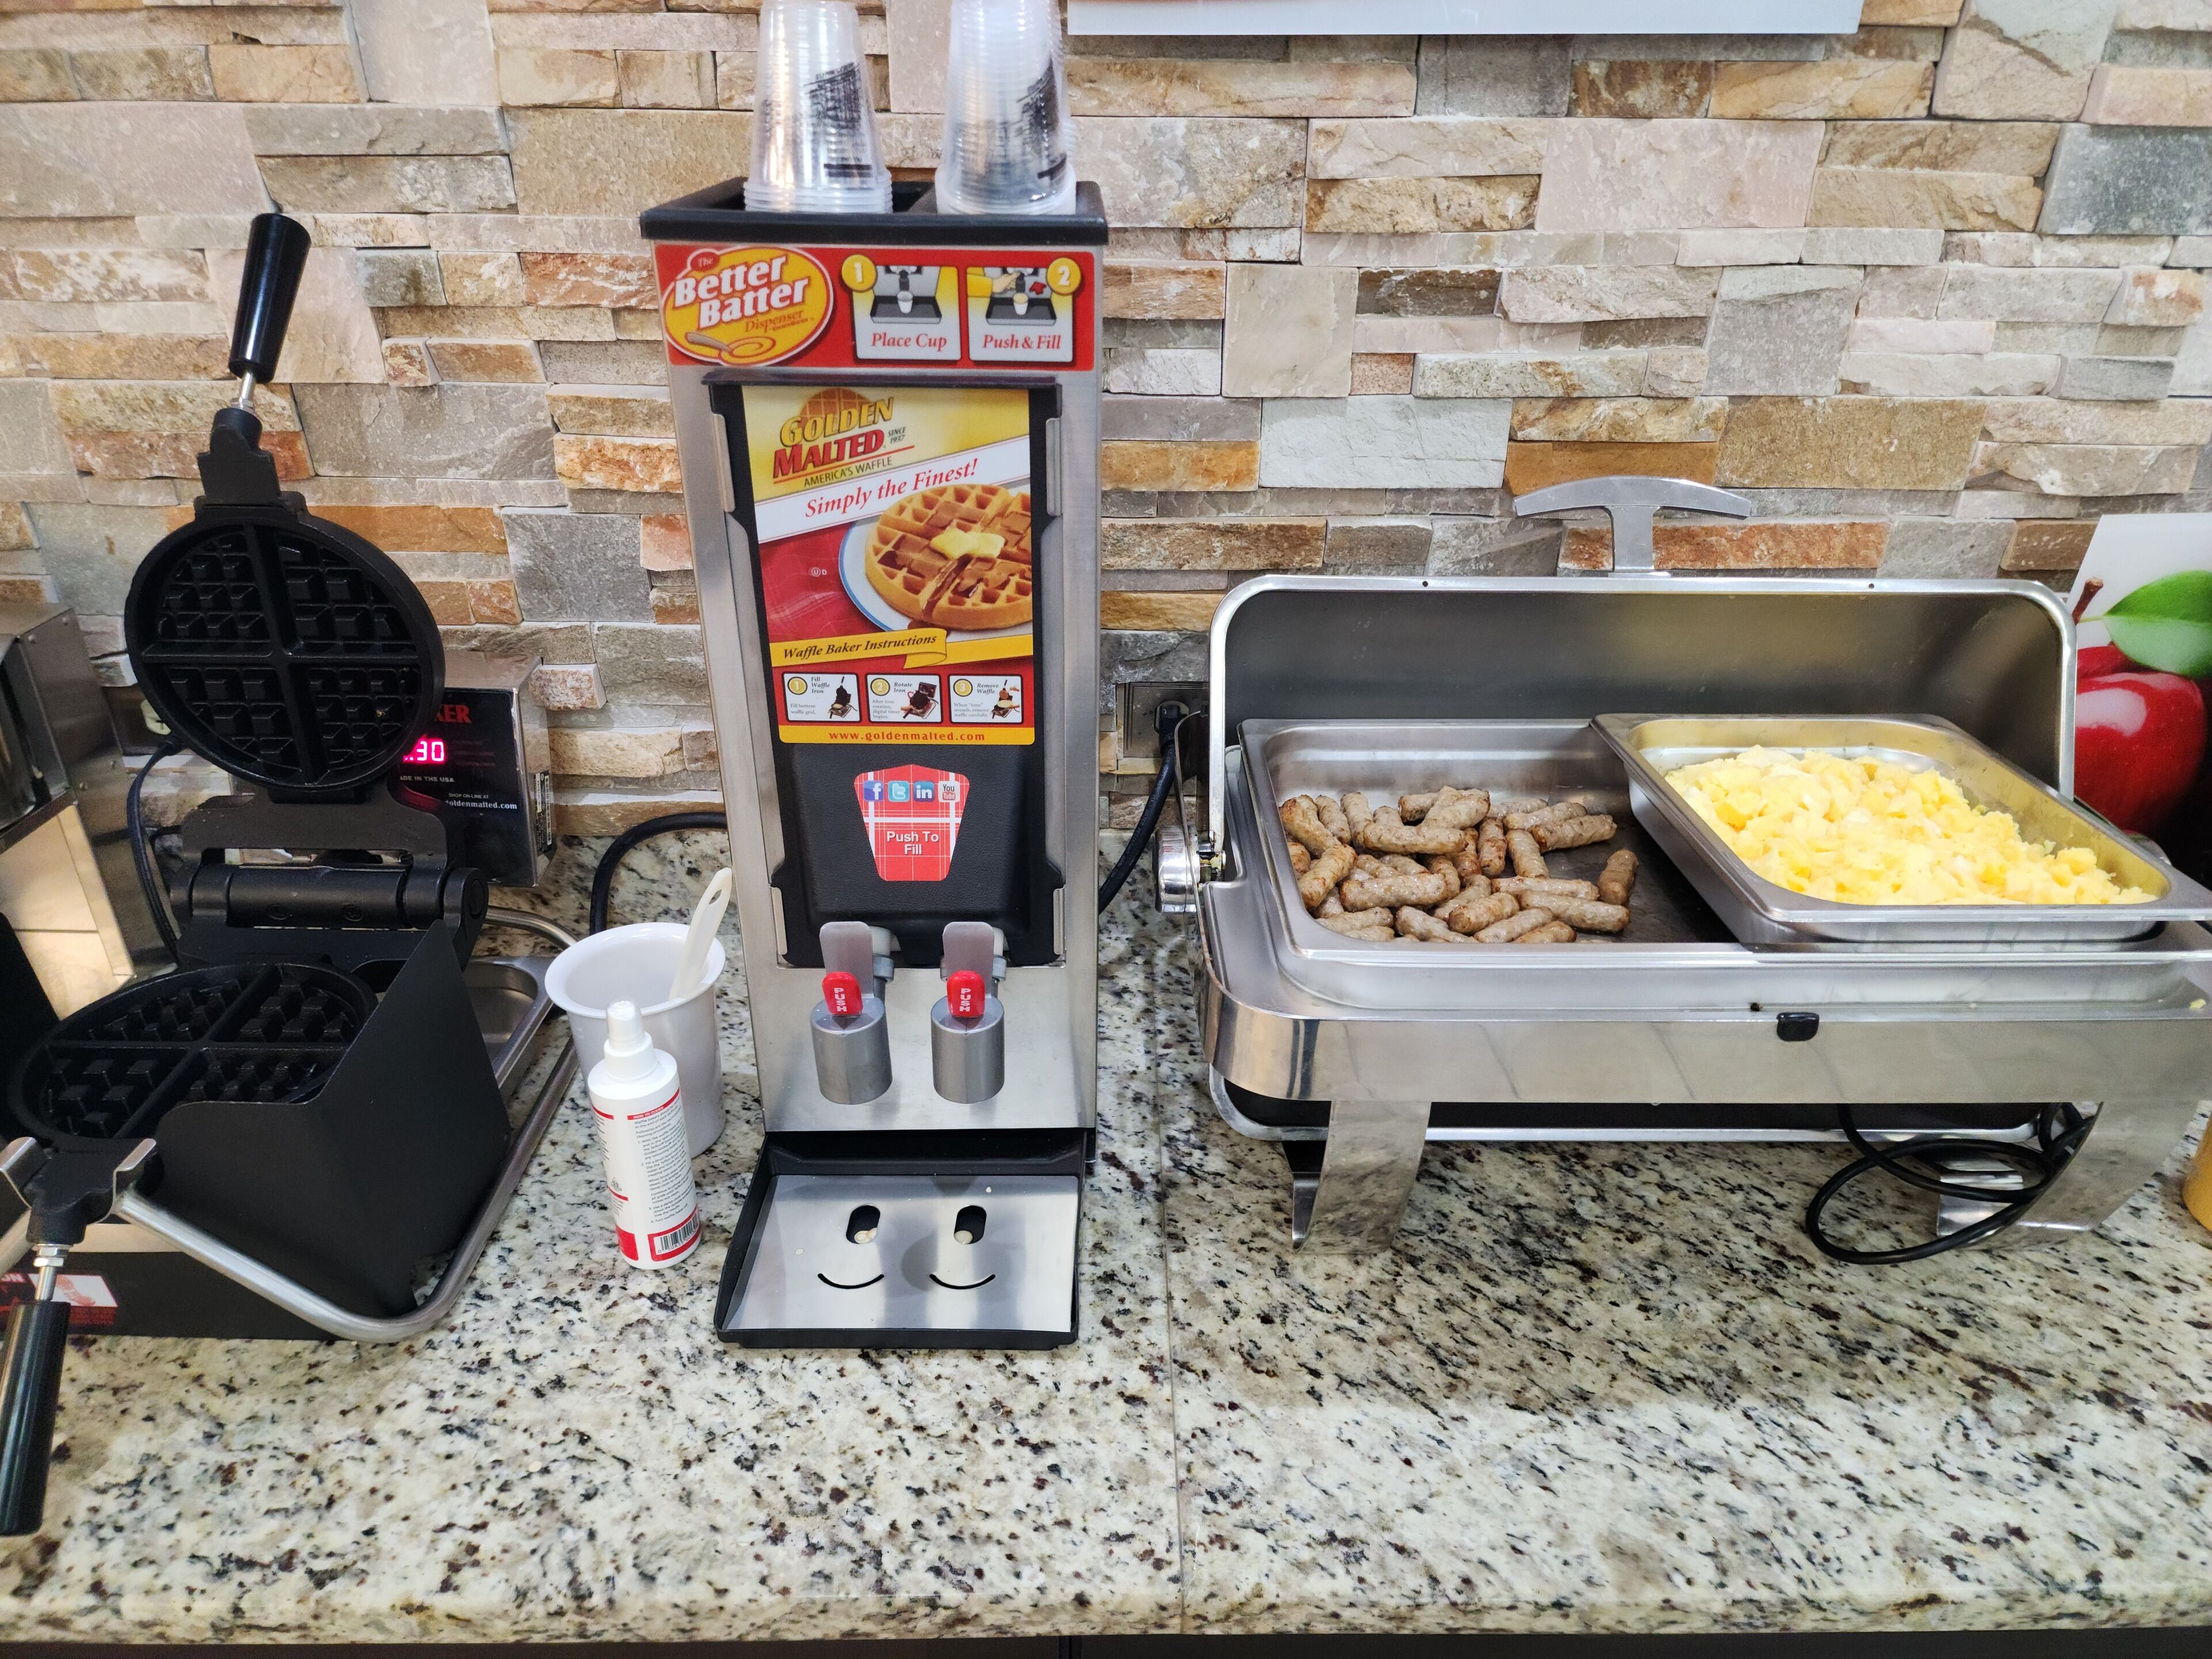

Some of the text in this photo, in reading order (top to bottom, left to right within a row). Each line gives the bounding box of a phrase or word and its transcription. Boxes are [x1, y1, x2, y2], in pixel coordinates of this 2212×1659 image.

[698, 257, 713, 267] The
[853, 262, 863, 283] 1
[675, 255, 786, 308] Better
[1058, 266, 1071, 286] 2
[699, 278, 809, 329] Batter
[745, 310, 804, 333] Dispenser
[871, 332, 948, 353] Place Cup
[983, 335, 1062, 350] Push & Fill
[780, 396, 894, 448] GOLDEN
[888, 426, 907, 437] SINCE
[890, 434, 906, 445] 1937
[773, 429, 885, 479] MALTED
[804, 456, 893, 488] AMERICA'S WAFFLE
[805, 457, 978, 518] Simply the Finest!
[783, 635, 937, 660] Waffle Baker Instructions
[828, 732, 986, 742] www.goldenmalted.com
[942, 783, 955, 792] You
[887, 831, 940, 843] Push To
[904, 844, 923, 855] Fill
[834, 987, 847, 1013] PUSH
[960, 988, 971, 1013] PUSH
